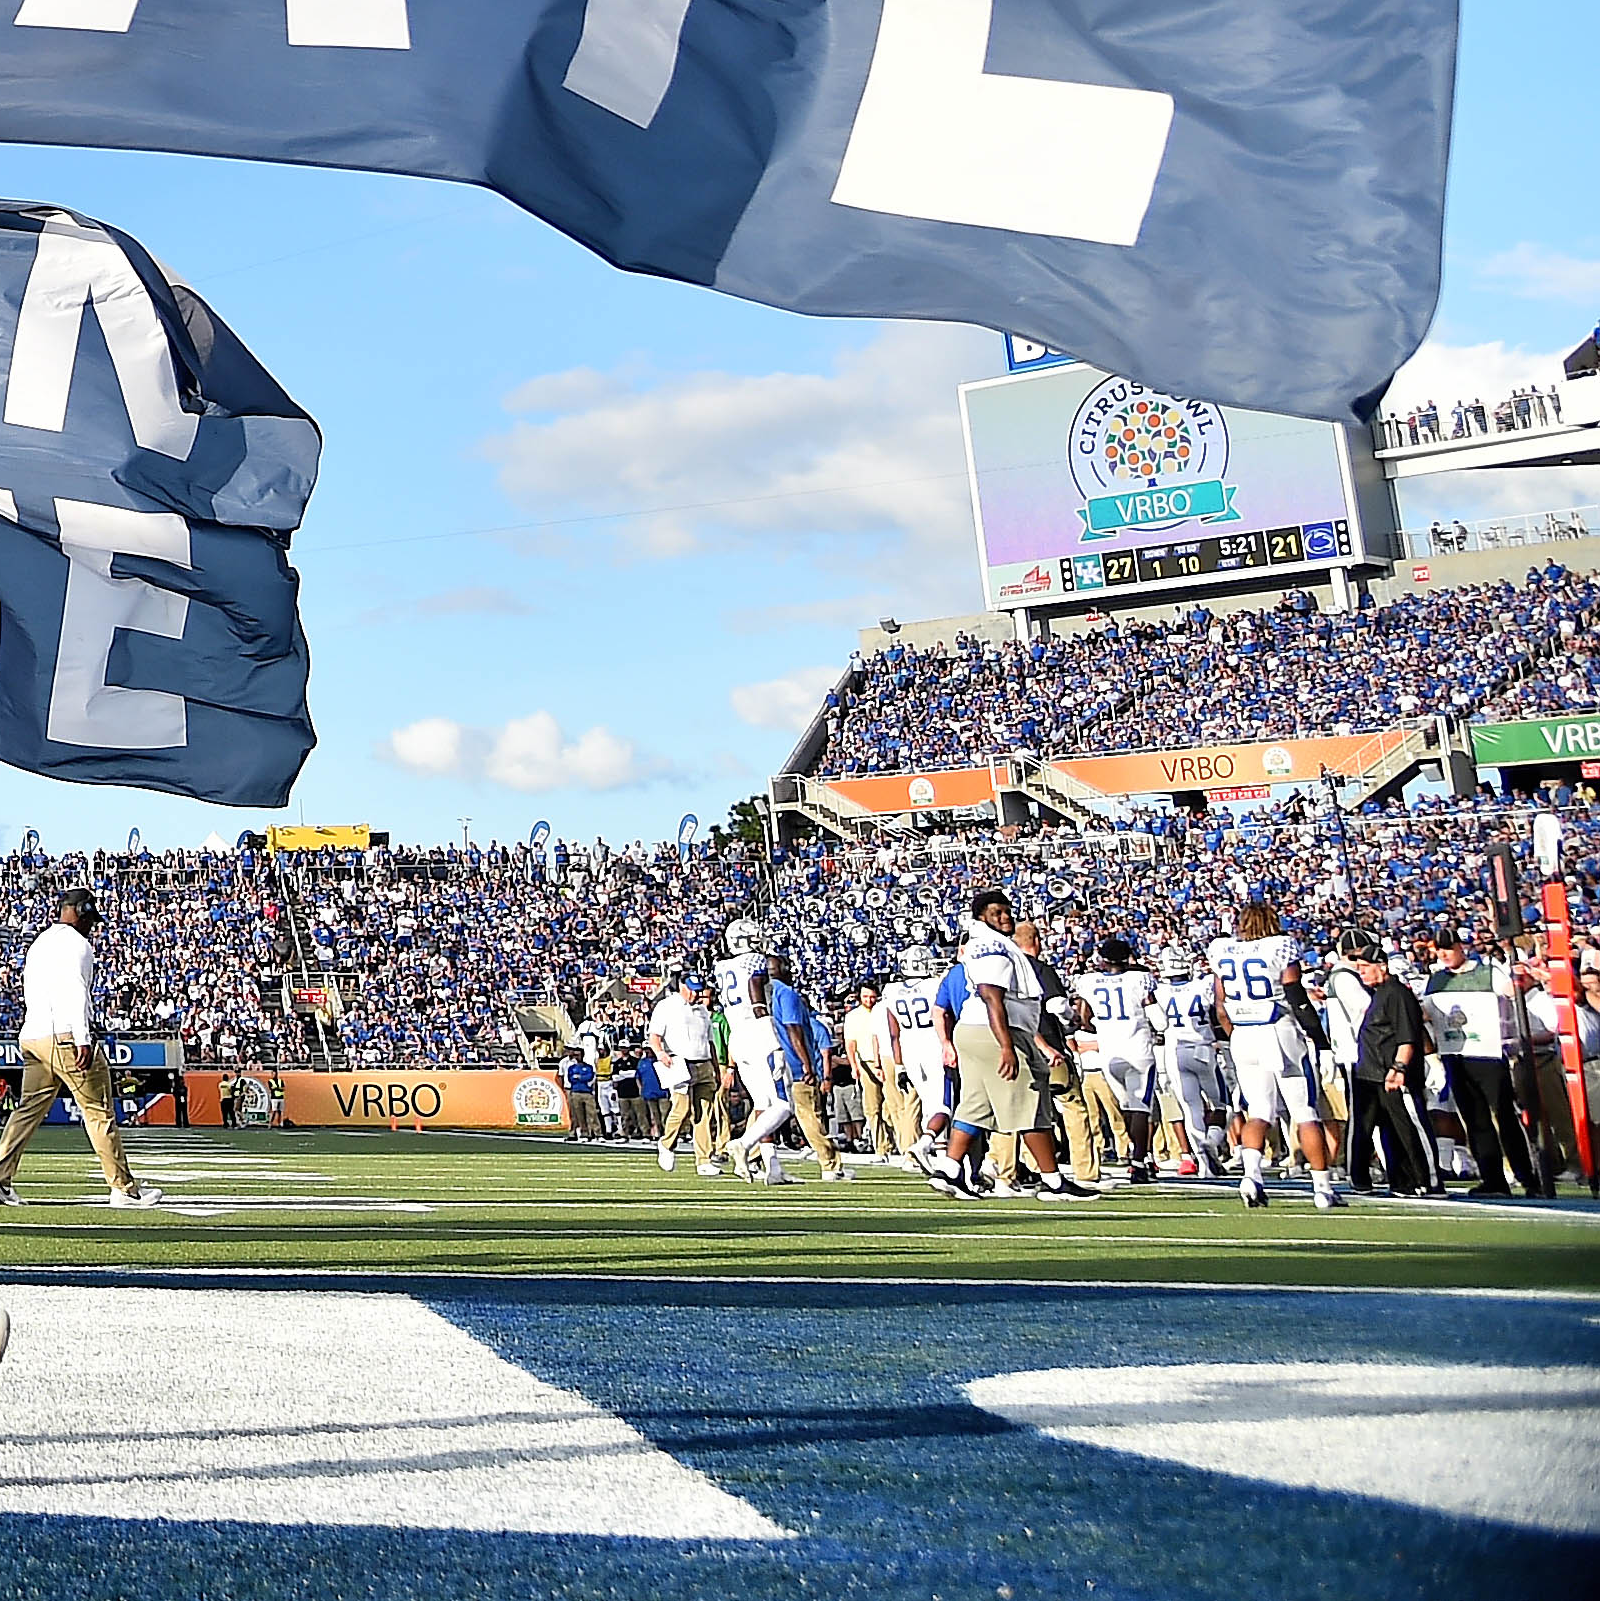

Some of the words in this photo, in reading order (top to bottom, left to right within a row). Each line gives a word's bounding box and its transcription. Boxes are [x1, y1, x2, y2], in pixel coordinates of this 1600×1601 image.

[1080, 380, 1144, 454] CITRUS
[1152, 390, 1214, 436] WL
[1115, 489, 1191, 524] VRBO
[1219, 535, 1258, 555] 5:21
[1245, 554, 1254, 566] 4
[1271, 534, 1299, 558] 21
[1106, 556, 1133, 580] 27
[1152, 560, 1162, 578] 1
[1178, 555, 1200, 575] 10
[1539, 722, 1600, 754] VRB
[1161, 754, 1234, 783] VRBO
[1218, 958, 1274, 1001] 26
[898, 997, 930, 1029] 92
[1093, 986, 1129, 1021] 31
[1166, 994, 1208, 1027] 44
[333, 1083, 442, 1118] VRBO
